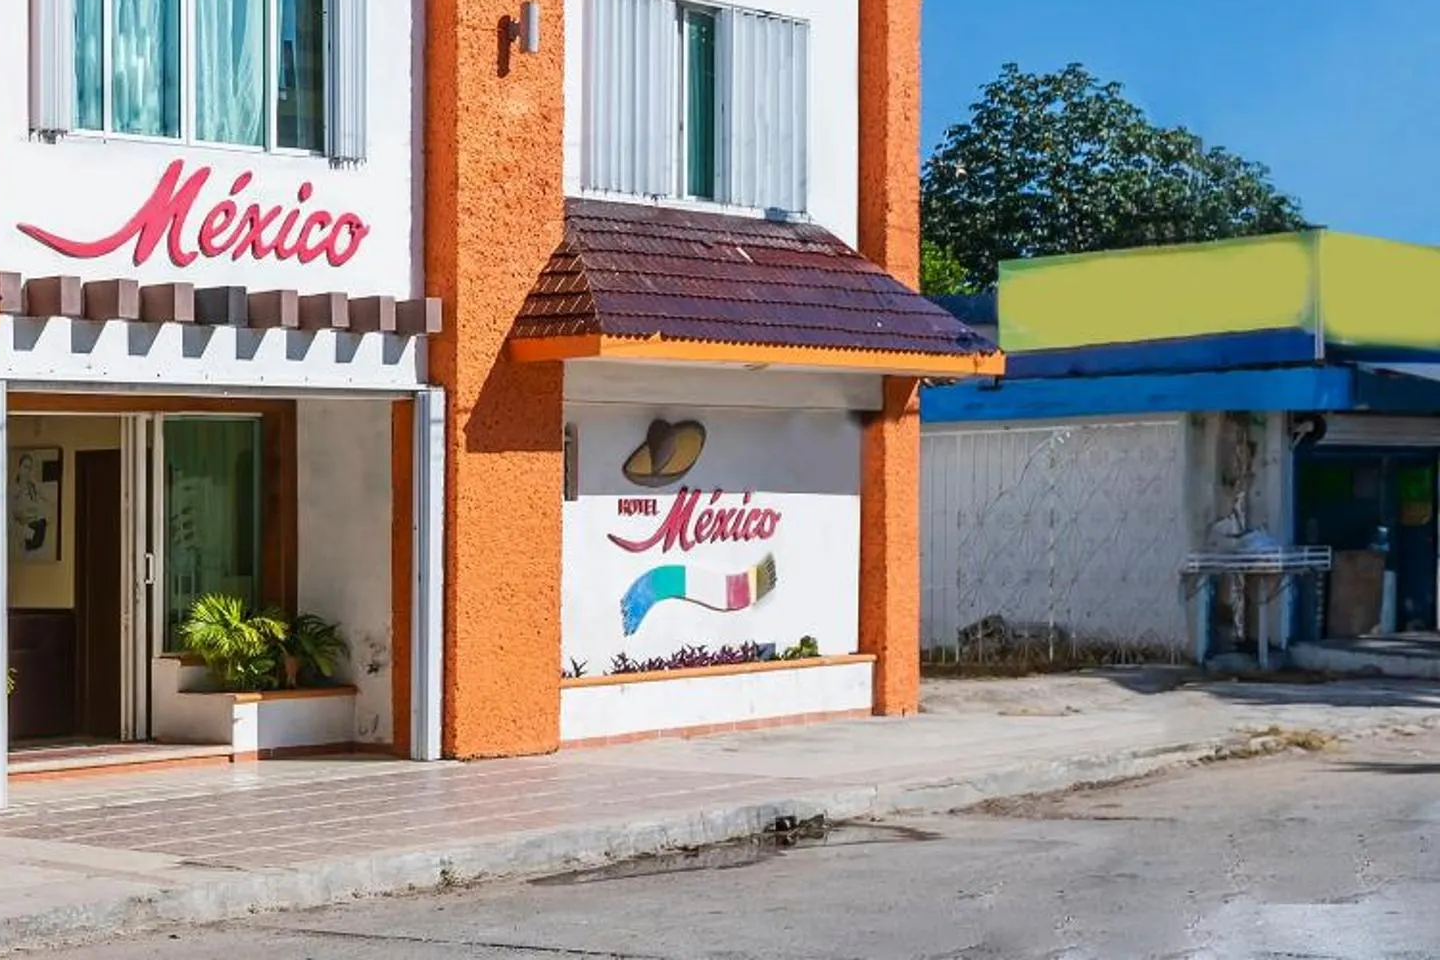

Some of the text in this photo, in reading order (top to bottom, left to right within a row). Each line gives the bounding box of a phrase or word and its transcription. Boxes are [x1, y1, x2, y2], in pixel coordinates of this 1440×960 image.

[16, 158, 370, 267] México
[607, 486, 781, 553] HOTEL México
